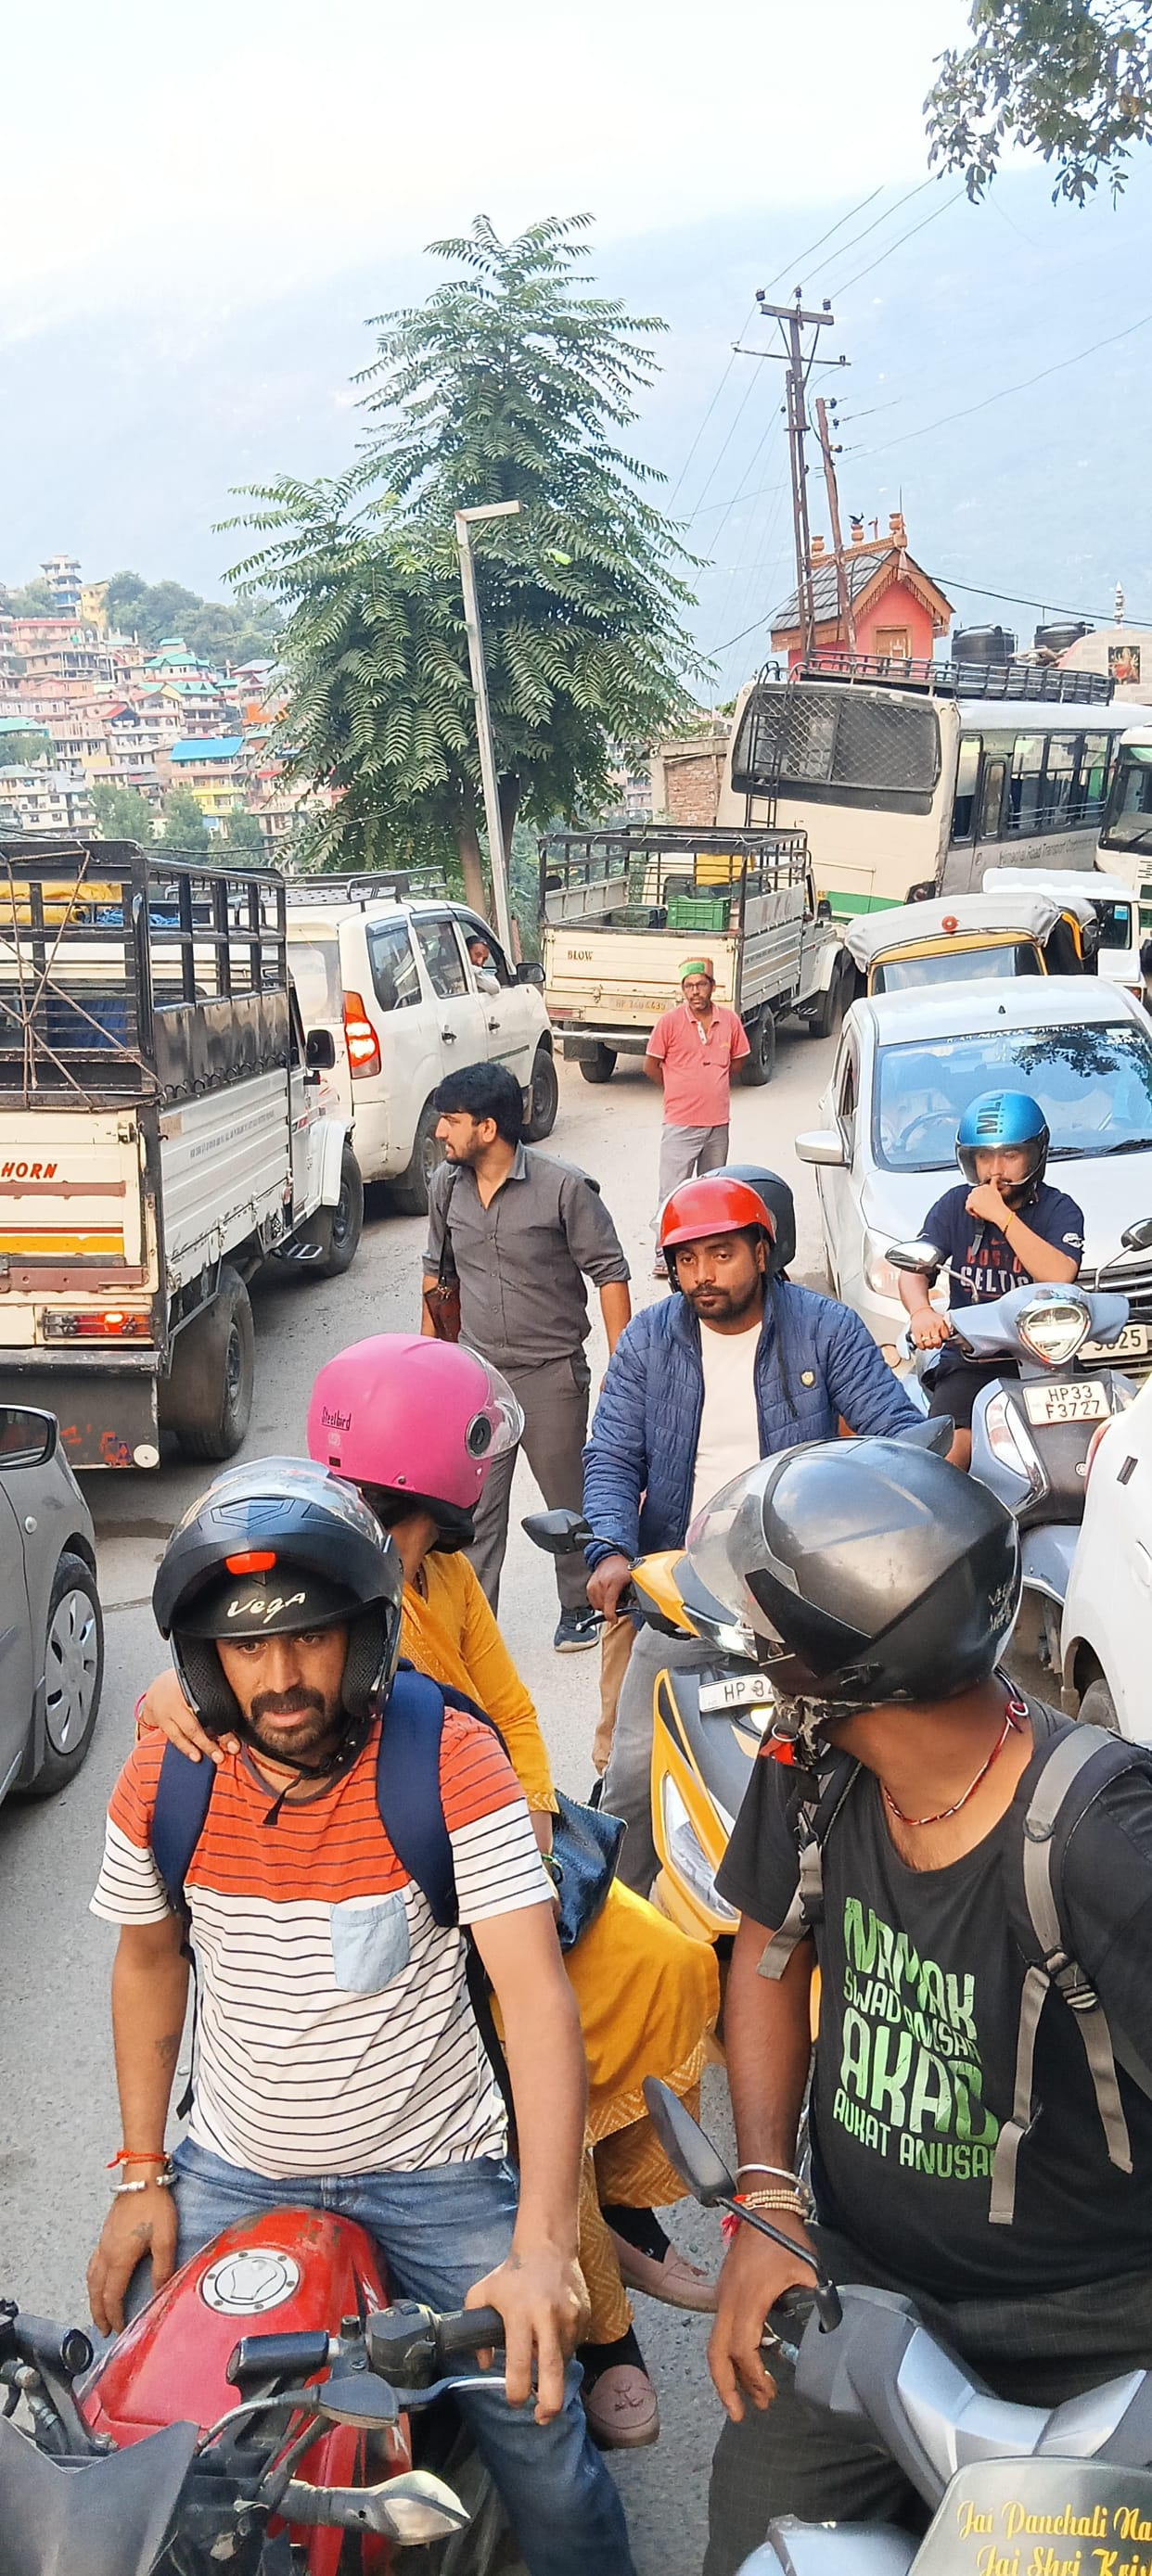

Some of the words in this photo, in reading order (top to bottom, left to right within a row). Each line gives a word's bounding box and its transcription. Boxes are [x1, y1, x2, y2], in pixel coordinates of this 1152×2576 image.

[568, 950, 593, 961] BLOW
[1, 1162, 58, 1180] HORN
[1048, 1385, 1093, 1402] HP33
[1045, 1400, 1100, 1419] F3727
[724, 1681, 745, 1702] HP
[844, 1897, 977, 2040] NAMAK
[843, 1966, 902, 2023] SWAD
[833, 2088, 890, 2157] AUKAT
[957, 2500, 993, 2541] Jai
[1001, 2500, 1107, 2541] Panchali
